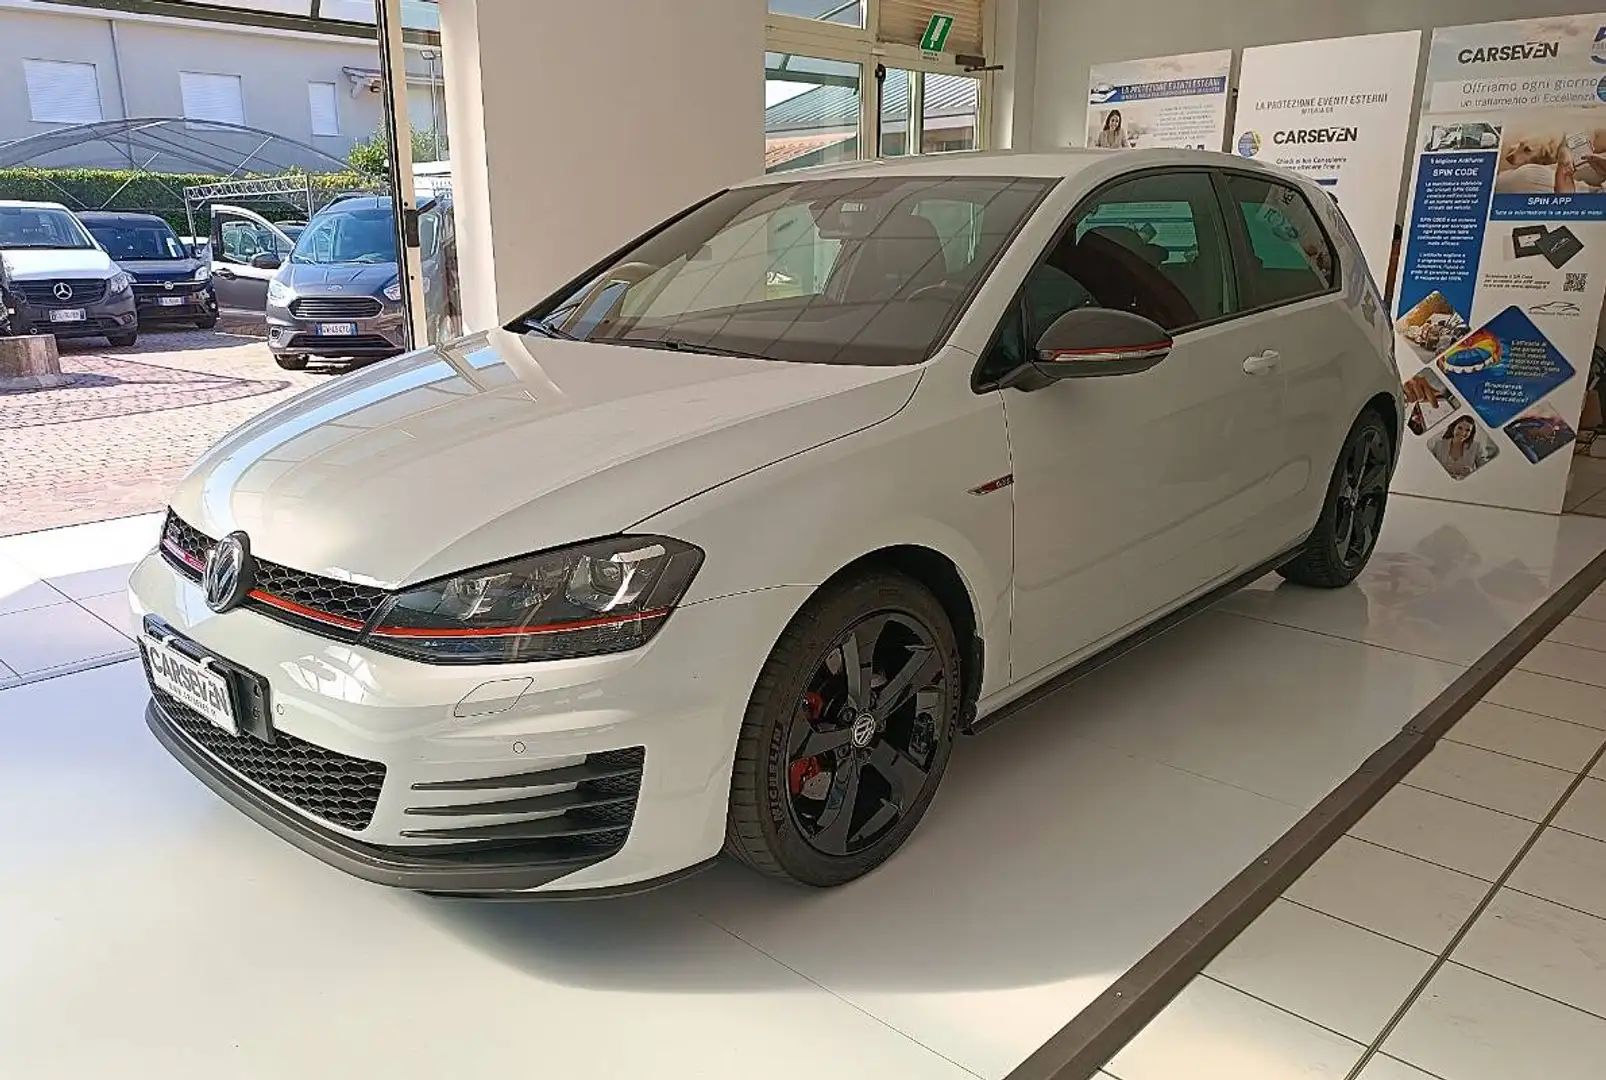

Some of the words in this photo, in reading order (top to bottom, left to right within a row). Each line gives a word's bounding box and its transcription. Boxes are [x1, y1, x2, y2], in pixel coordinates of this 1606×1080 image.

[1458, 41, 1559, 64] CARSEVEN
[1462, 80, 1517, 94] Offriamo
[1522, 79, 1549, 93] ogni
[1554, 77, 1597, 92] giorno
[1256, 101, 1264, 111] LA
[1267, 98, 1315, 110] PROTEZIONE
[1317, 95, 1348, 106] EVENTI
[1350, 93, 1388, 104] ESTERNI
[1460, 99, 1472, 108] un
[1475, 96, 1527, 107] trattamento
[1531, 94, 1540, 104] di
[1273, 127, 1358, 144] CARSEVEN
[1455, 168, 1479, 176] CODE
[1527, 197, 1549, 205] SPIN
[1551, 197, 1572, 205] APP
[149, 646, 230, 717] CARSEVEN
